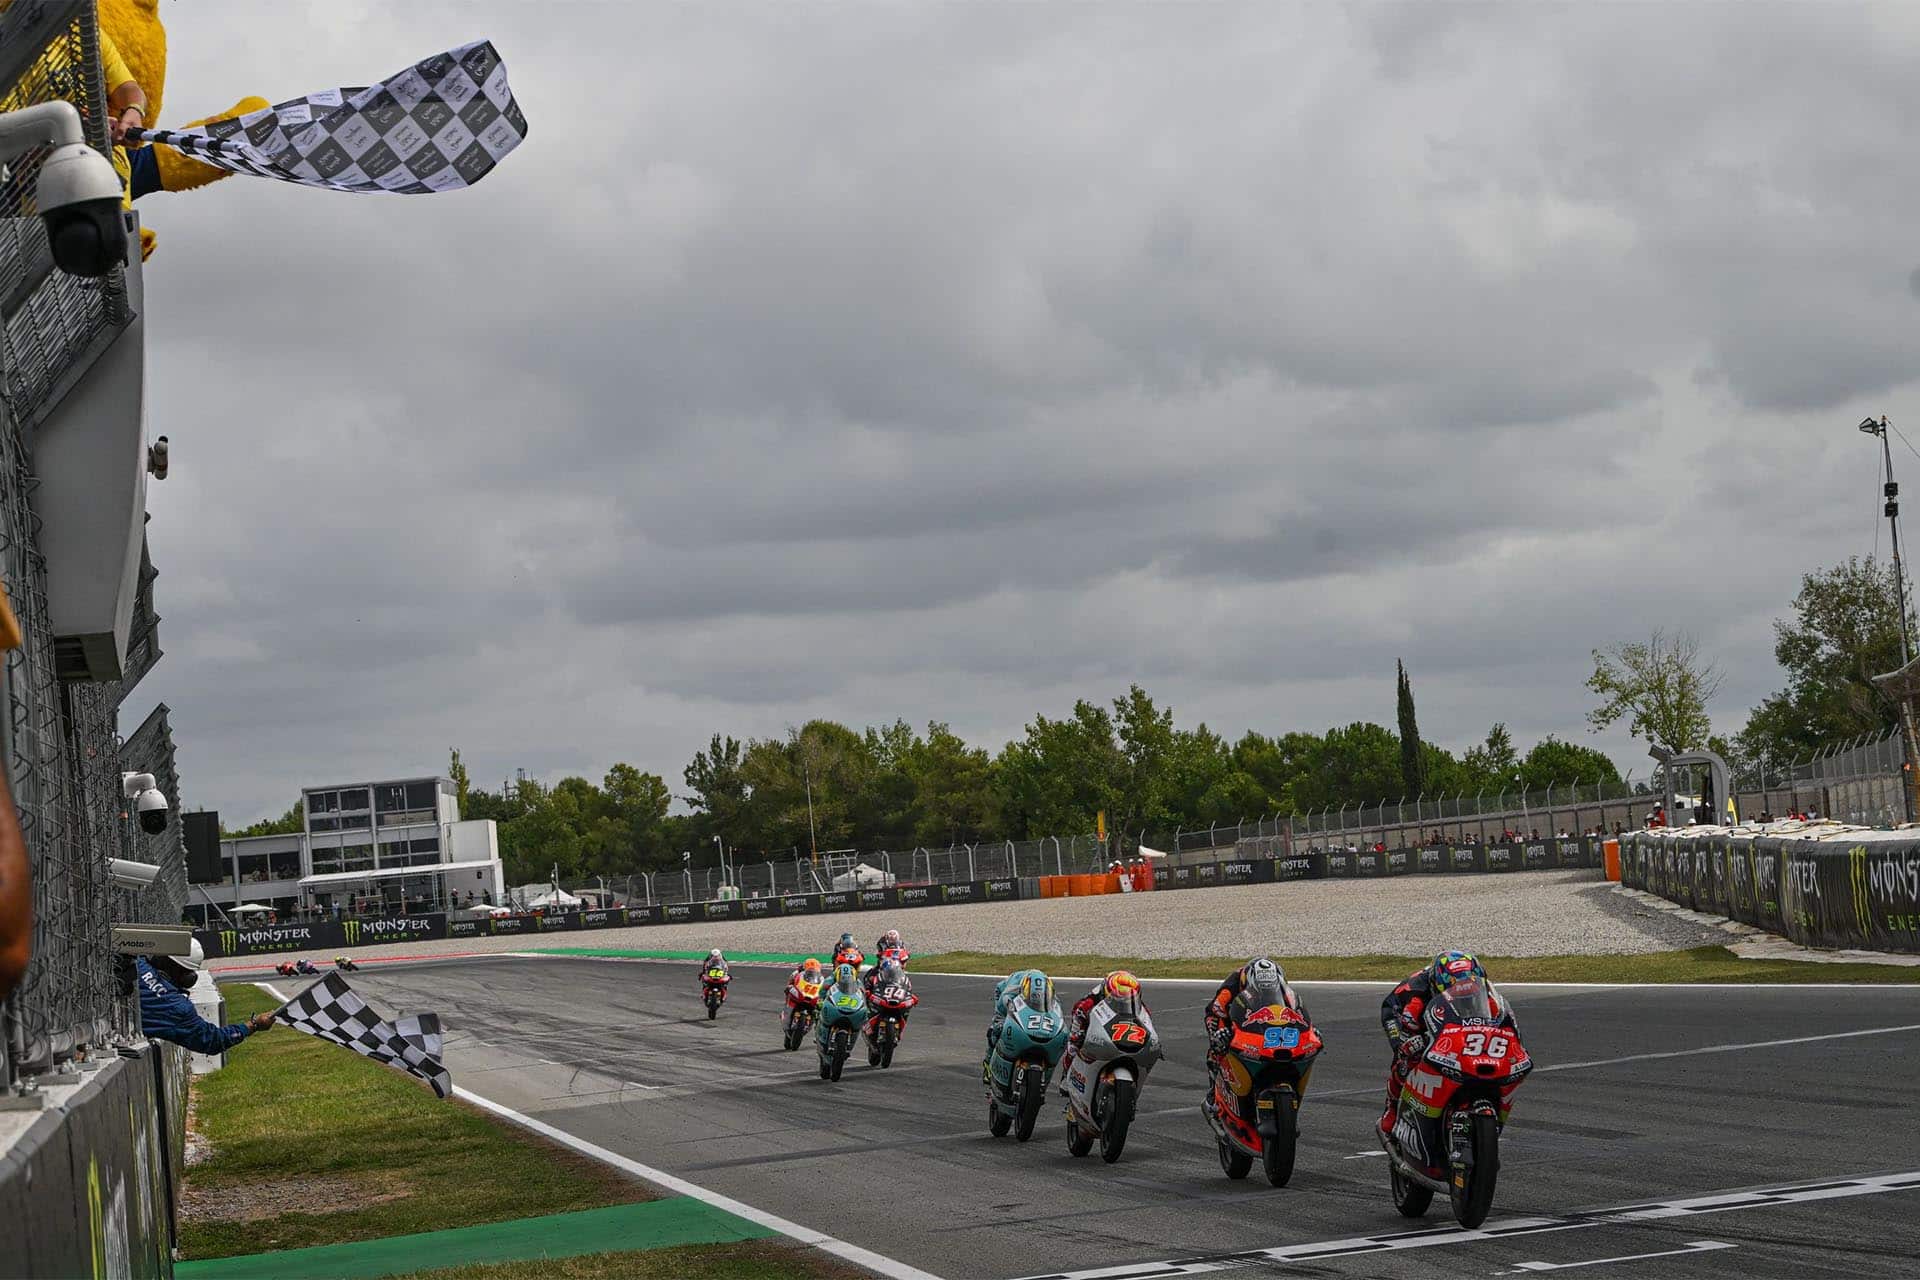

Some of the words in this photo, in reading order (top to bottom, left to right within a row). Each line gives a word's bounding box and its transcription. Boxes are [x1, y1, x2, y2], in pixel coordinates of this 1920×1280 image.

[1870, 850, 1920, 904] MONS
[1887, 914, 1920, 931] ENE
[239, 928, 311, 944] MONSTER
[141, 972, 167, 997] RACC
[1027, 1015, 1055, 1032] 22
[1111, 1023, 1147, 1045] 72
[1263, 1026, 1300, 1048] 99
[1462, 1033, 1509, 1058] 36
[1407, 1068, 1443, 1099] MT
